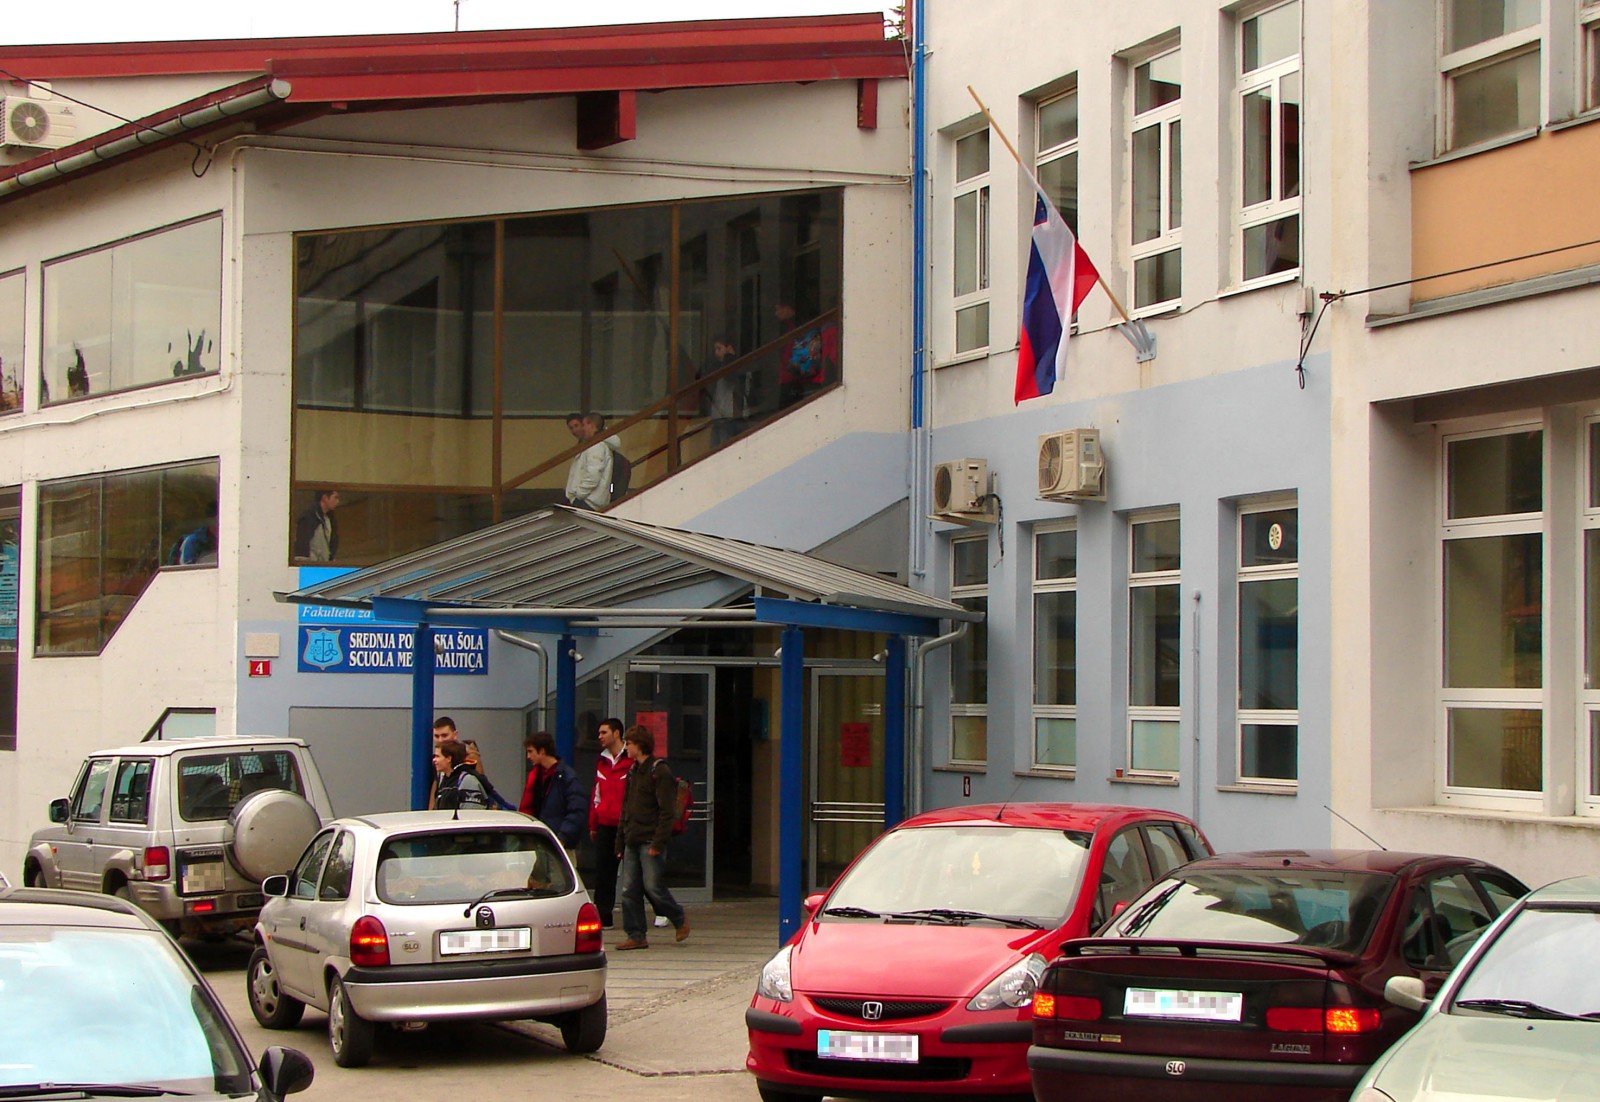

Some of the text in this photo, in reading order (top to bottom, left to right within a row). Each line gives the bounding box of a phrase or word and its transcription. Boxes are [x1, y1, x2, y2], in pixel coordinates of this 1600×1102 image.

[302, 605, 371, 618] Fakulteta za
[349, 632, 396, 649] SREDNJA
[457, 631, 484, 650] ŠOLA
[349, 651, 394, 667] SCUOLA
[397, 651, 413, 667] ME
[255, 662, 264, 675] 4
[1167, 1062, 1185, 1074] SLO
